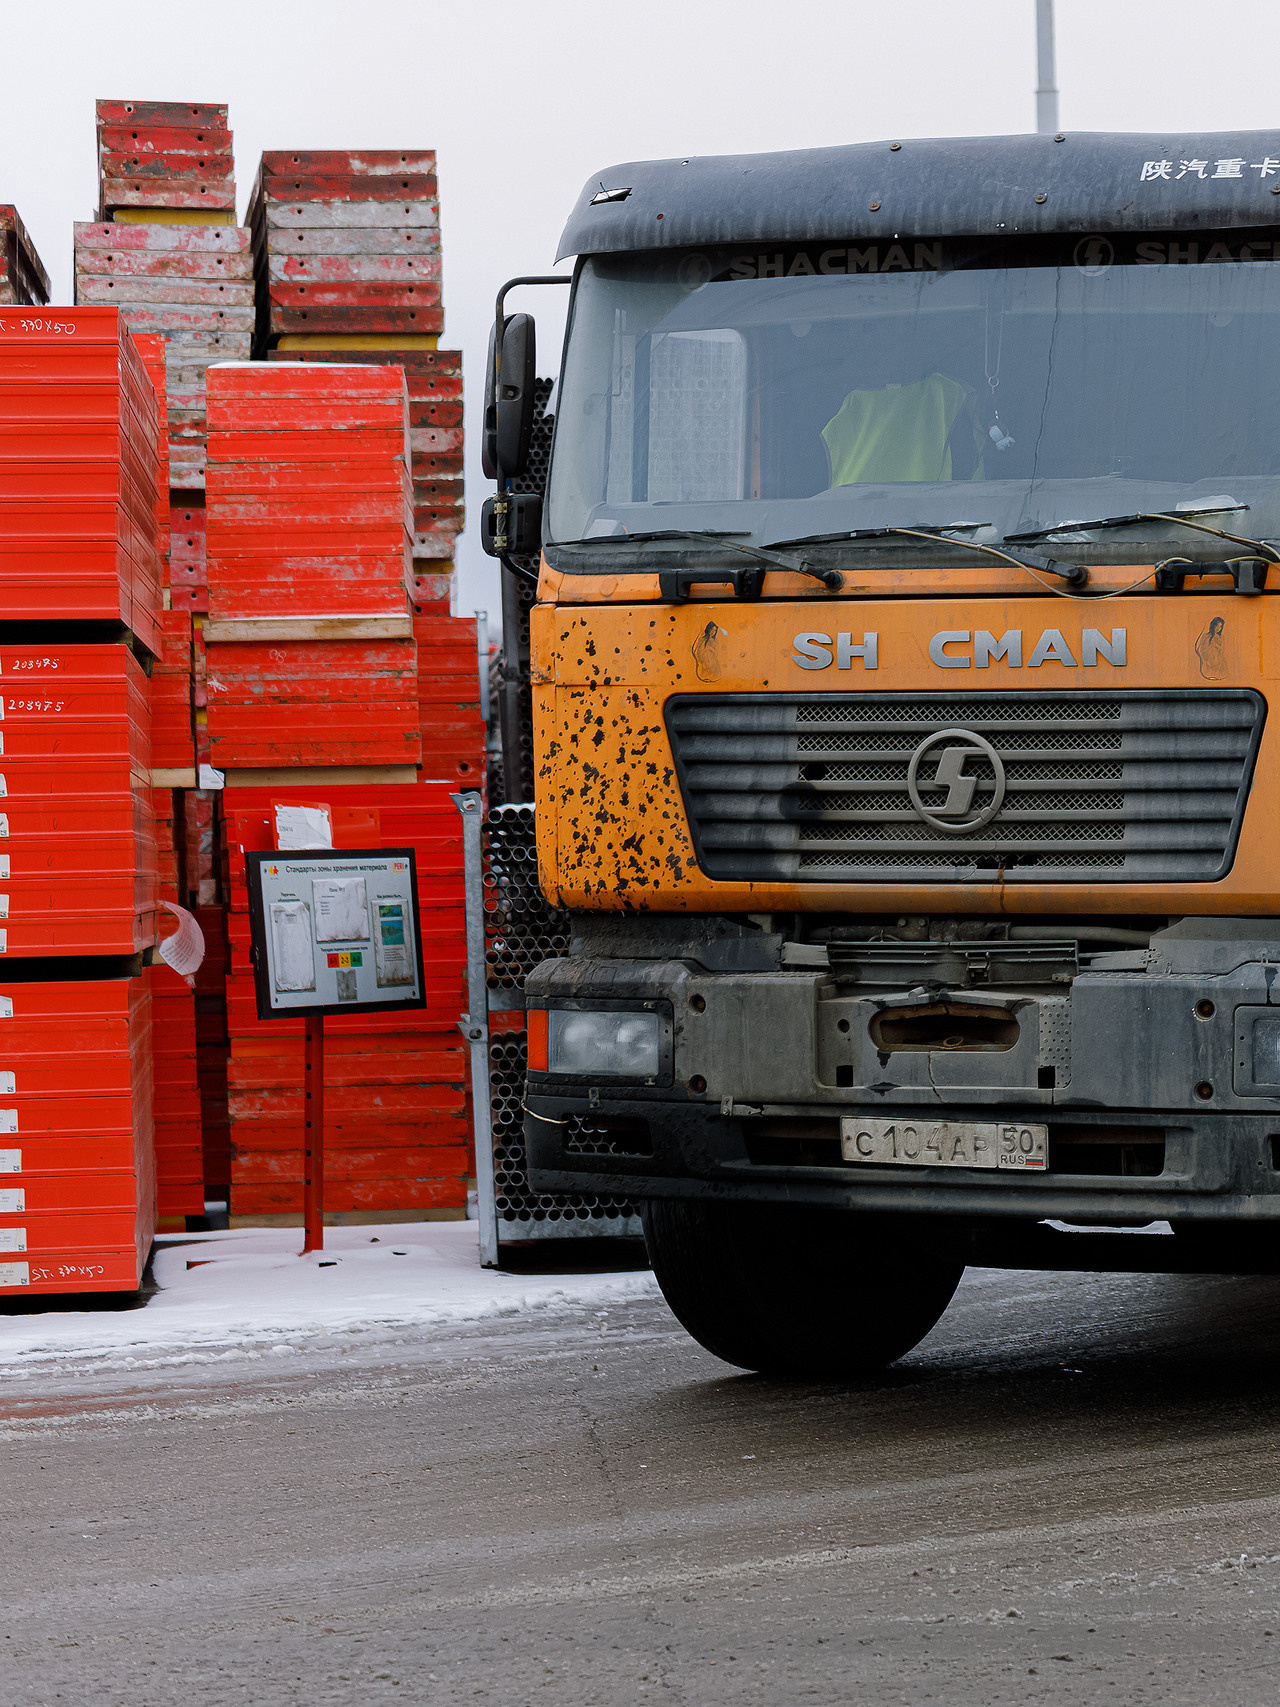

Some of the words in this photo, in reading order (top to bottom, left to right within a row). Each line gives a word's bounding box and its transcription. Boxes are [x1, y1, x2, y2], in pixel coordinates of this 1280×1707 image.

[1139, 157, 1280, 182] 陕汽重卡
[729, 242, 942, 280] SHACMAN
[8, 698, 65, 712] 203475
[285, 865, 317, 874] Стандарты
[1002, 1126, 1034, 1155] 50
[1000, 1154, 1025, 1165] RUS
